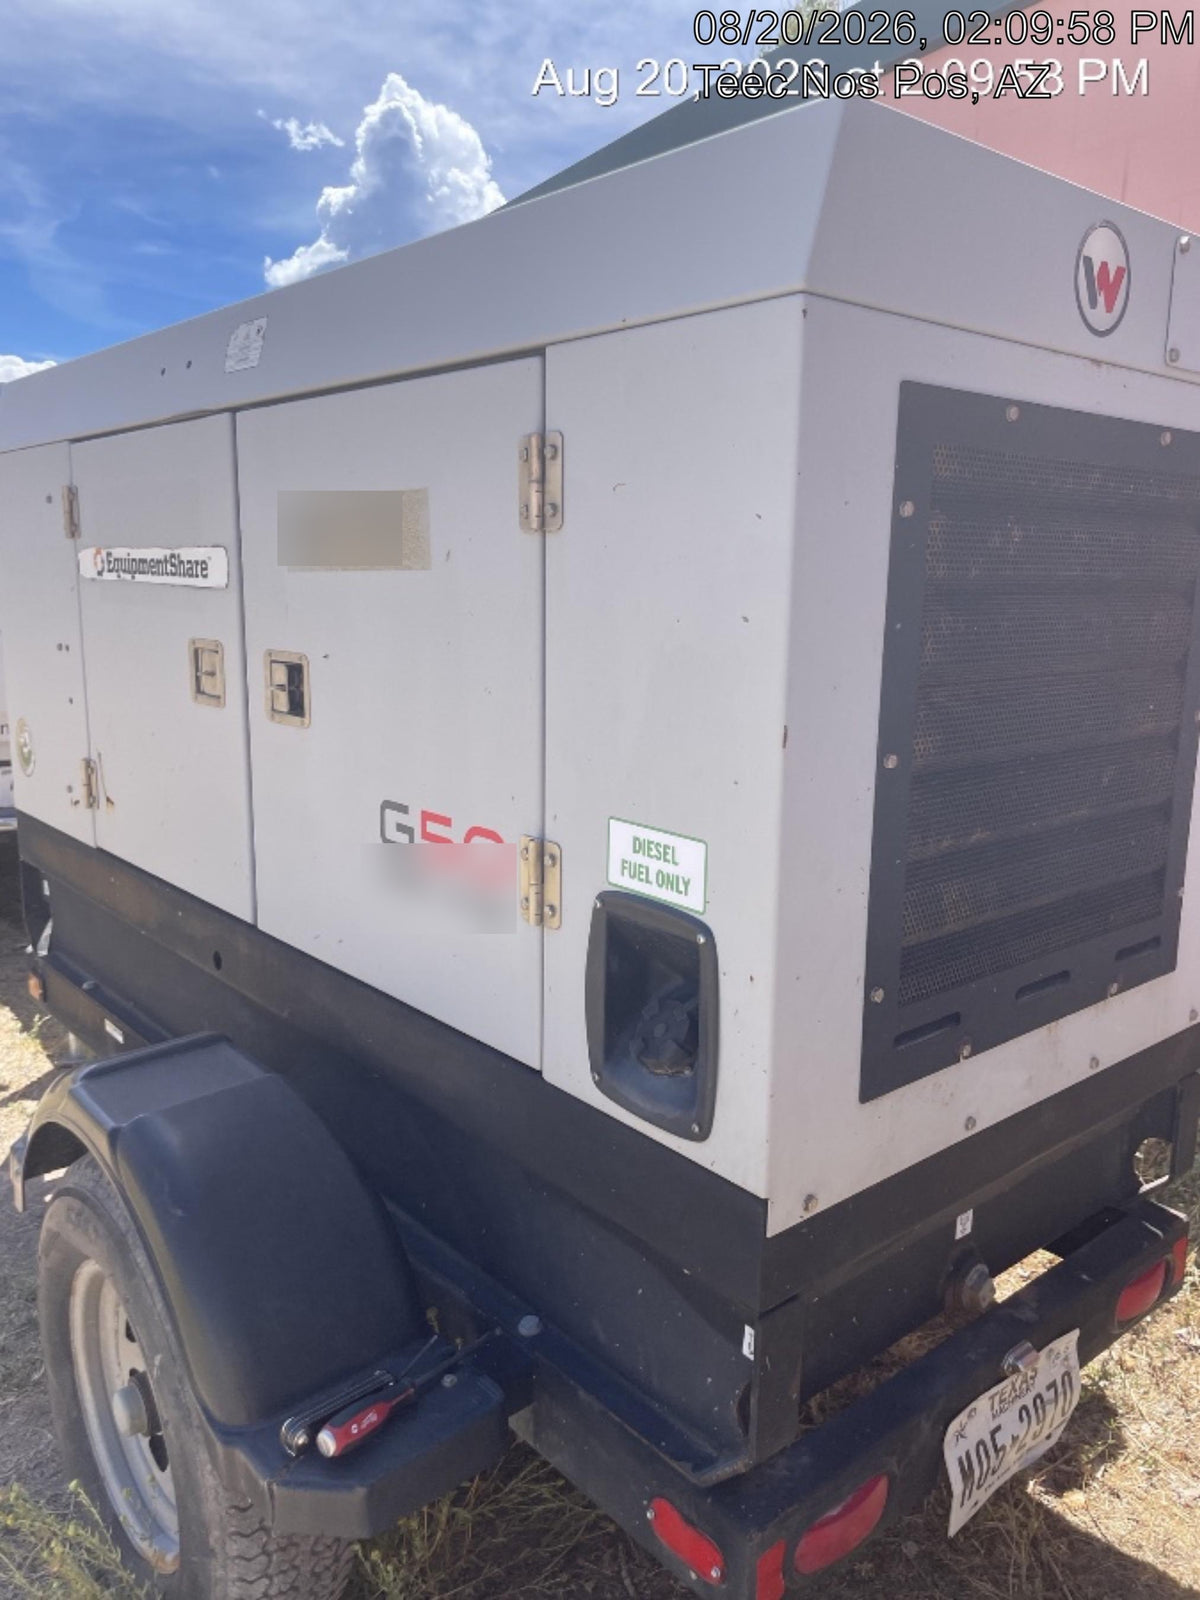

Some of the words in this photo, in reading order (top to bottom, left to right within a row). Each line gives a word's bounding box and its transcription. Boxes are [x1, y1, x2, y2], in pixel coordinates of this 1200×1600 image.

[106, 551, 209, 579] EquipmentShare
[632, 835, 679, 866] DIESEL
[620, 858, 653, 885] FUEL
[656, 868, 691, 896] ONLY
[988, 1367, 1038, 1412] TEXAS
